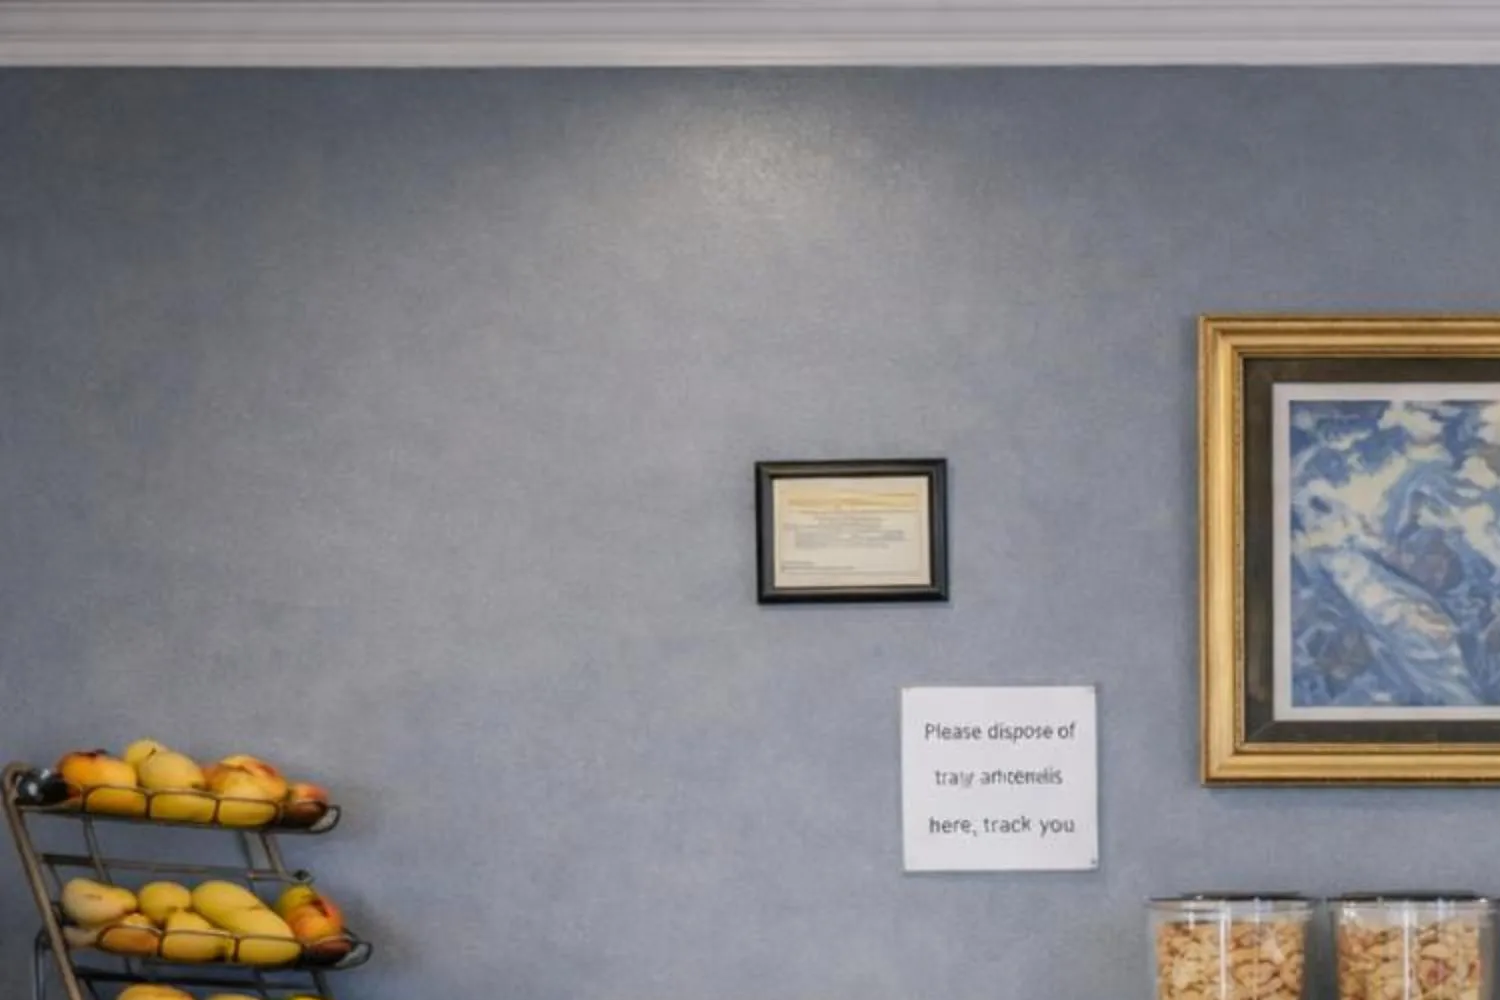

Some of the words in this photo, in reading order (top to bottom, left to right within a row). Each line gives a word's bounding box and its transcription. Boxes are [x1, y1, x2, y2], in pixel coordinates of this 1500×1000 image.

[924, 722, 982, 741] Please
[987, 722, 1054, 744] dispose
[1057, 721, 1075, 740] of
[928, 815, 977, 837] here,
[983, 815, 1031, 834] track
[1039, 817, 1076, 838] you
